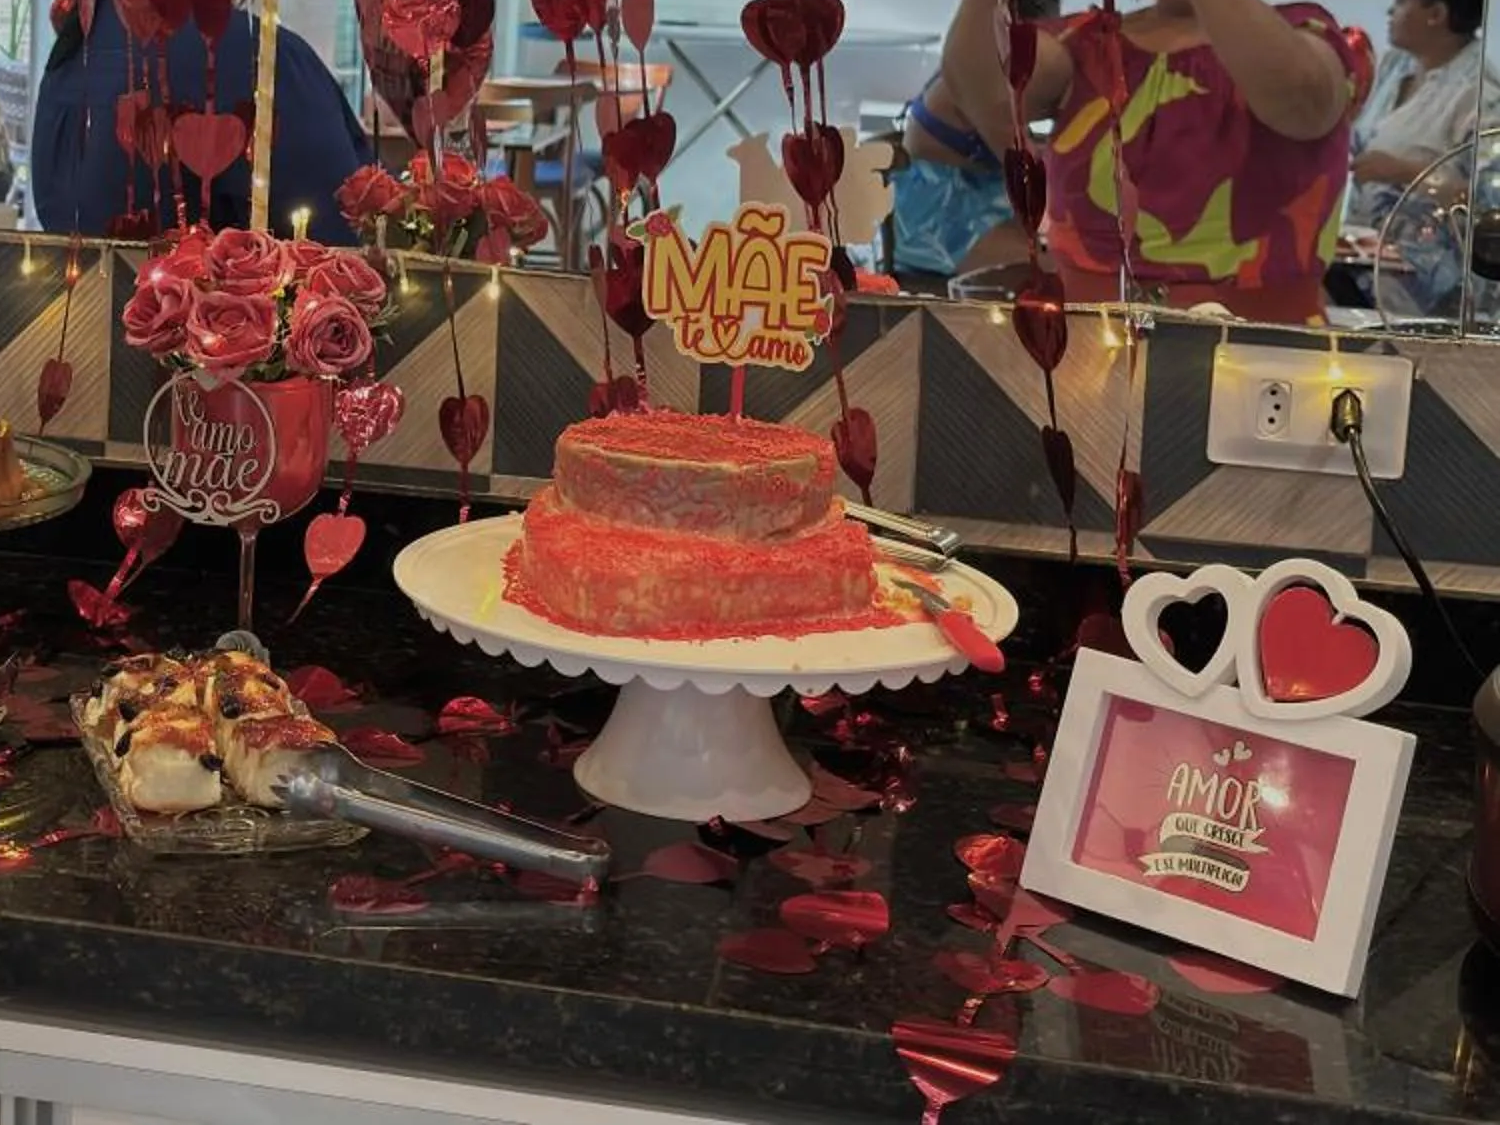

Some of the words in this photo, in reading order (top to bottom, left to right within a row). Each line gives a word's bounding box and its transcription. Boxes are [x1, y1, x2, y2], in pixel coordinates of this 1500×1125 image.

[650, 209, 828, 330] MÃE
[749, 334, 808, 365] amo
[191, 421, 257, 453] amo
[162, 449, 260, 493] mãe
[1166, 761, 1262, 832] AMOR
